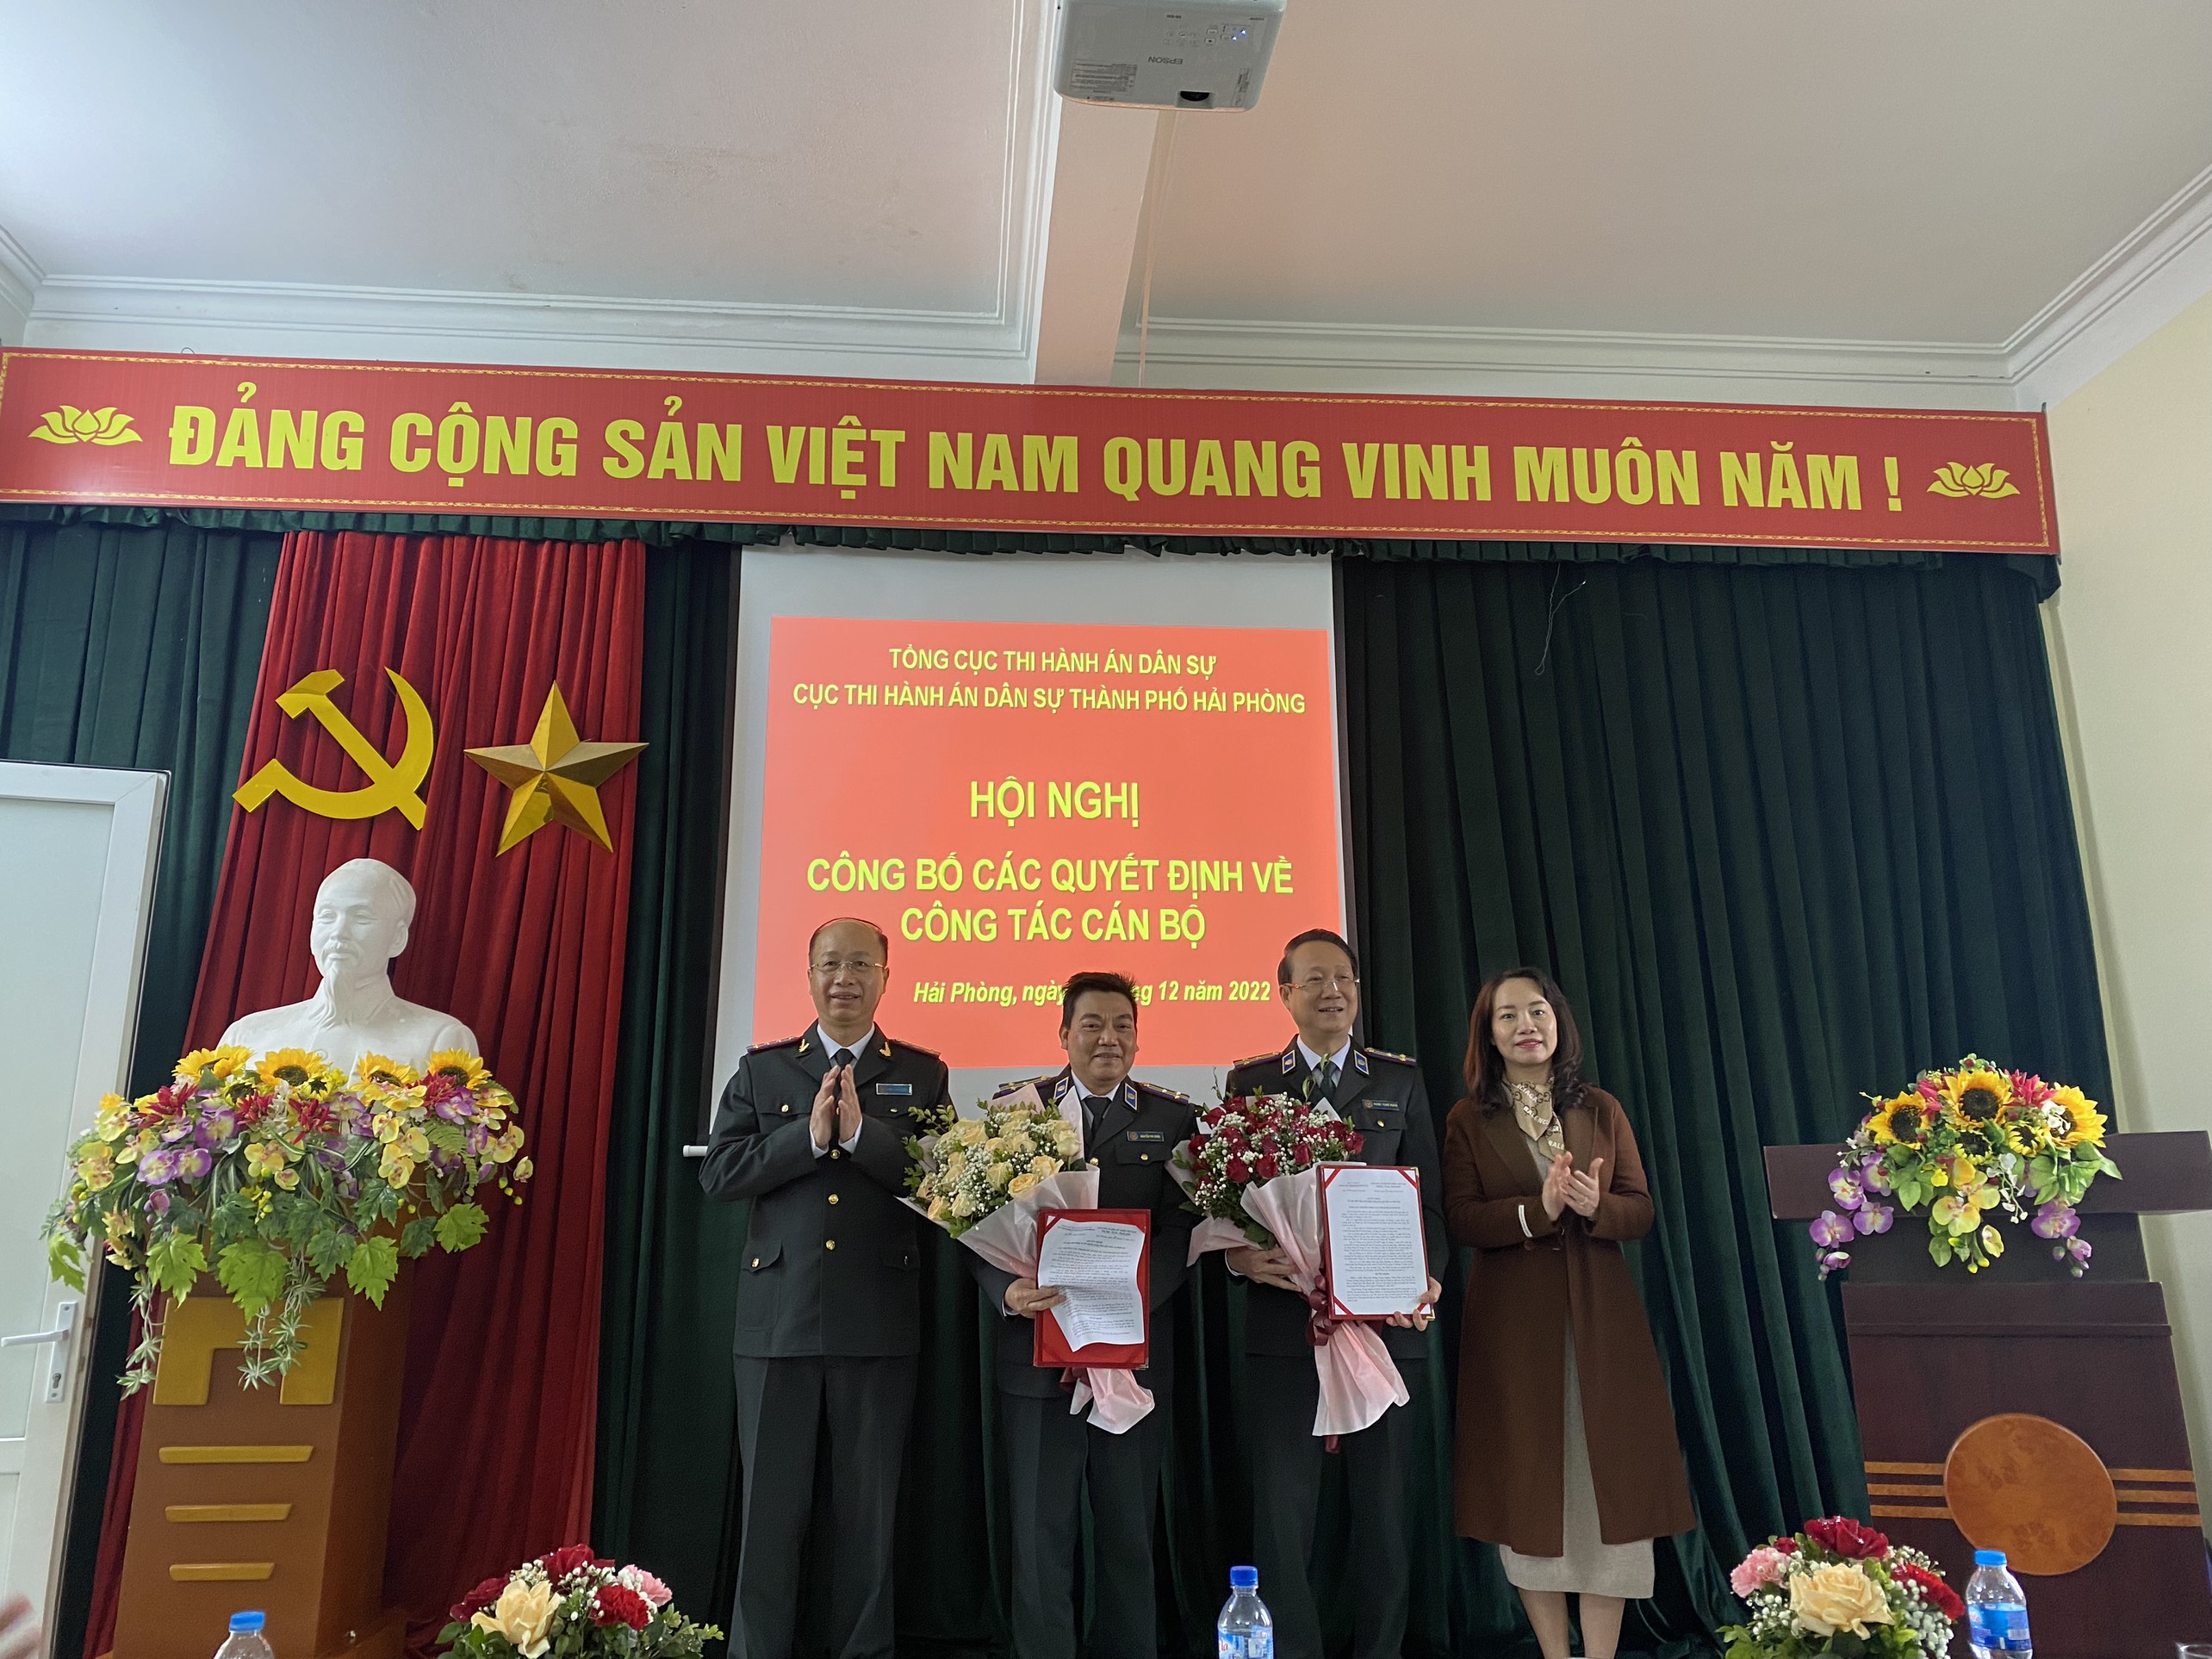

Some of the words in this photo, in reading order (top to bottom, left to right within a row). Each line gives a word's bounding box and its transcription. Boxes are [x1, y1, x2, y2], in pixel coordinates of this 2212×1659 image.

[1147, 56, 1184, 65] EPSON
[168, 382, 365, 471] ĐẢNG
[389, 401, 579, 488] CỘNG
[602, 395, 743, 482] SẢN
[766, 415, 906, 500] VIỆT
[929, 432, 1078, 493] NAM
[1103, 437, 1321, 502] QUANG
[1341, 442, 1492, 501] VINH
[1513, 436, 1700, 506] MUÔN
[1719, 440, 1862, 511] NĂM
[1884, 457, 1903, 512] !
[888, 643, 949, 670] TỔNG
[954, 649, 998, 674] CỤC
[1003, 650, 1035, 672] THI
[1041, 647, 1099, 673] HÀNH
[1103, 648, 1133, 674] ÁN
[1139, 649, 1181, 674] DÂN
[1186, 655, 1217, 680] SỰ
[792, 682, 839, 710] CỤC
[843, 684, 878, 705] THI
[884, 680, 944, 706] HÀNH
[948, 681, 979, 707] ÁN
[984, 681, 1028, 708] DÂN
[1033, 687, 1065, 714] SỰ
[1068, 684, 1140, 710] THÀNH
[1145, 686, 1188, 711] PHỐ
[1193, 687, 1227, 712] HẢI
[1233, 687, 1305, 714] PHÒNG
[971, 775, 1035, 827] HỘI
[1047, 780, 1139, 828] NGHỊ
[807, 849, 905, 892] CÔNG
[916, 851, 963, 892] BỐ
[972, 850, 1041, 891] CÁC
[1050, 852, 1159, 893] QUYẾT
[1166, 859, 1243, 900] ĐỊNH
[1251, 855, 1294, 894] VỀ
[900, 899, 997, 942] CÔNG
[1007, 899, 1072, 941] TÁC
[1081, 900, 1150, 941] CÁN
[1159, 904, 1206, 949] BỘ
[913, 981, 946, 1003] Hải
[949, 980, 1017, 1007] Phòng,
[1159, 980, 1179, 1001] 12
[1183, 979, 1223, 1001] năm
[1227, 980, 1271, 1001] 2022
